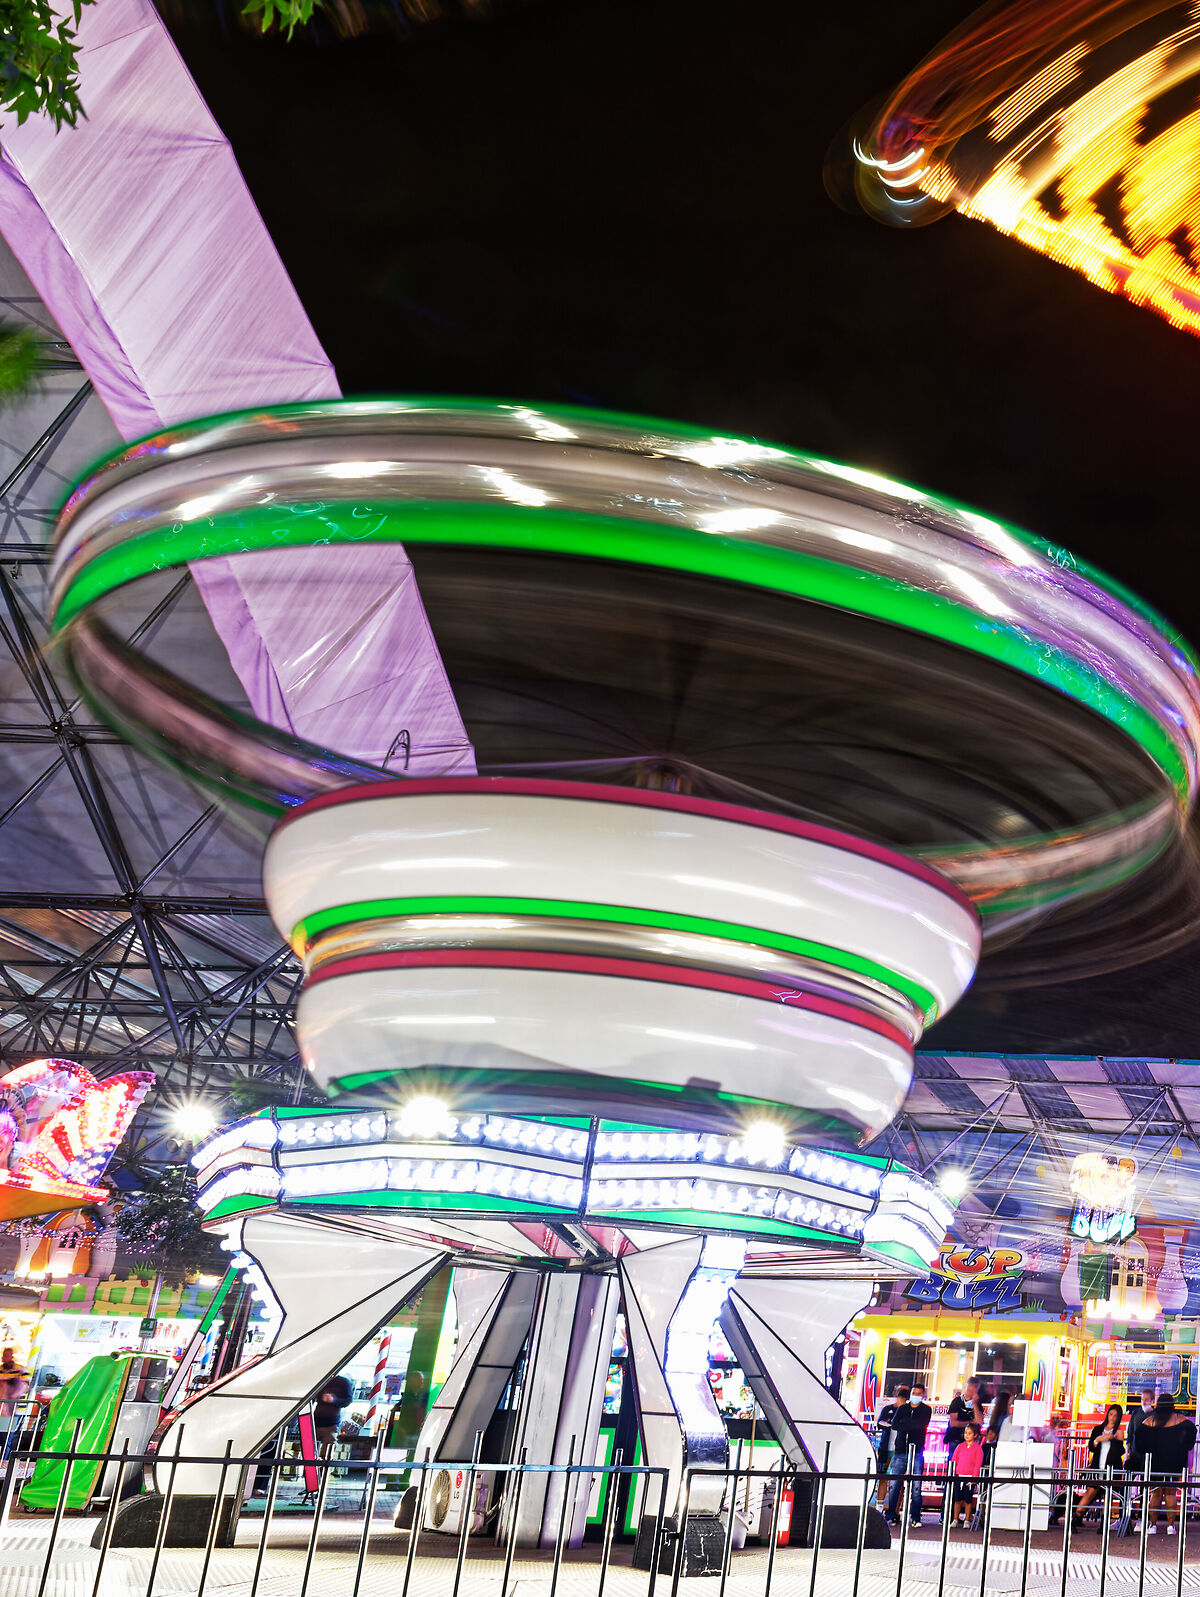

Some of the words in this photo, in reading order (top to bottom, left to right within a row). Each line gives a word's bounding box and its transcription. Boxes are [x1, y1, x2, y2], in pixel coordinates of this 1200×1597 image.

[930, 1244, 1024, 1276] TOP
[903, 1272, 1026, 1312] BUZZ
[453, 1491, 460, 1499] LG
